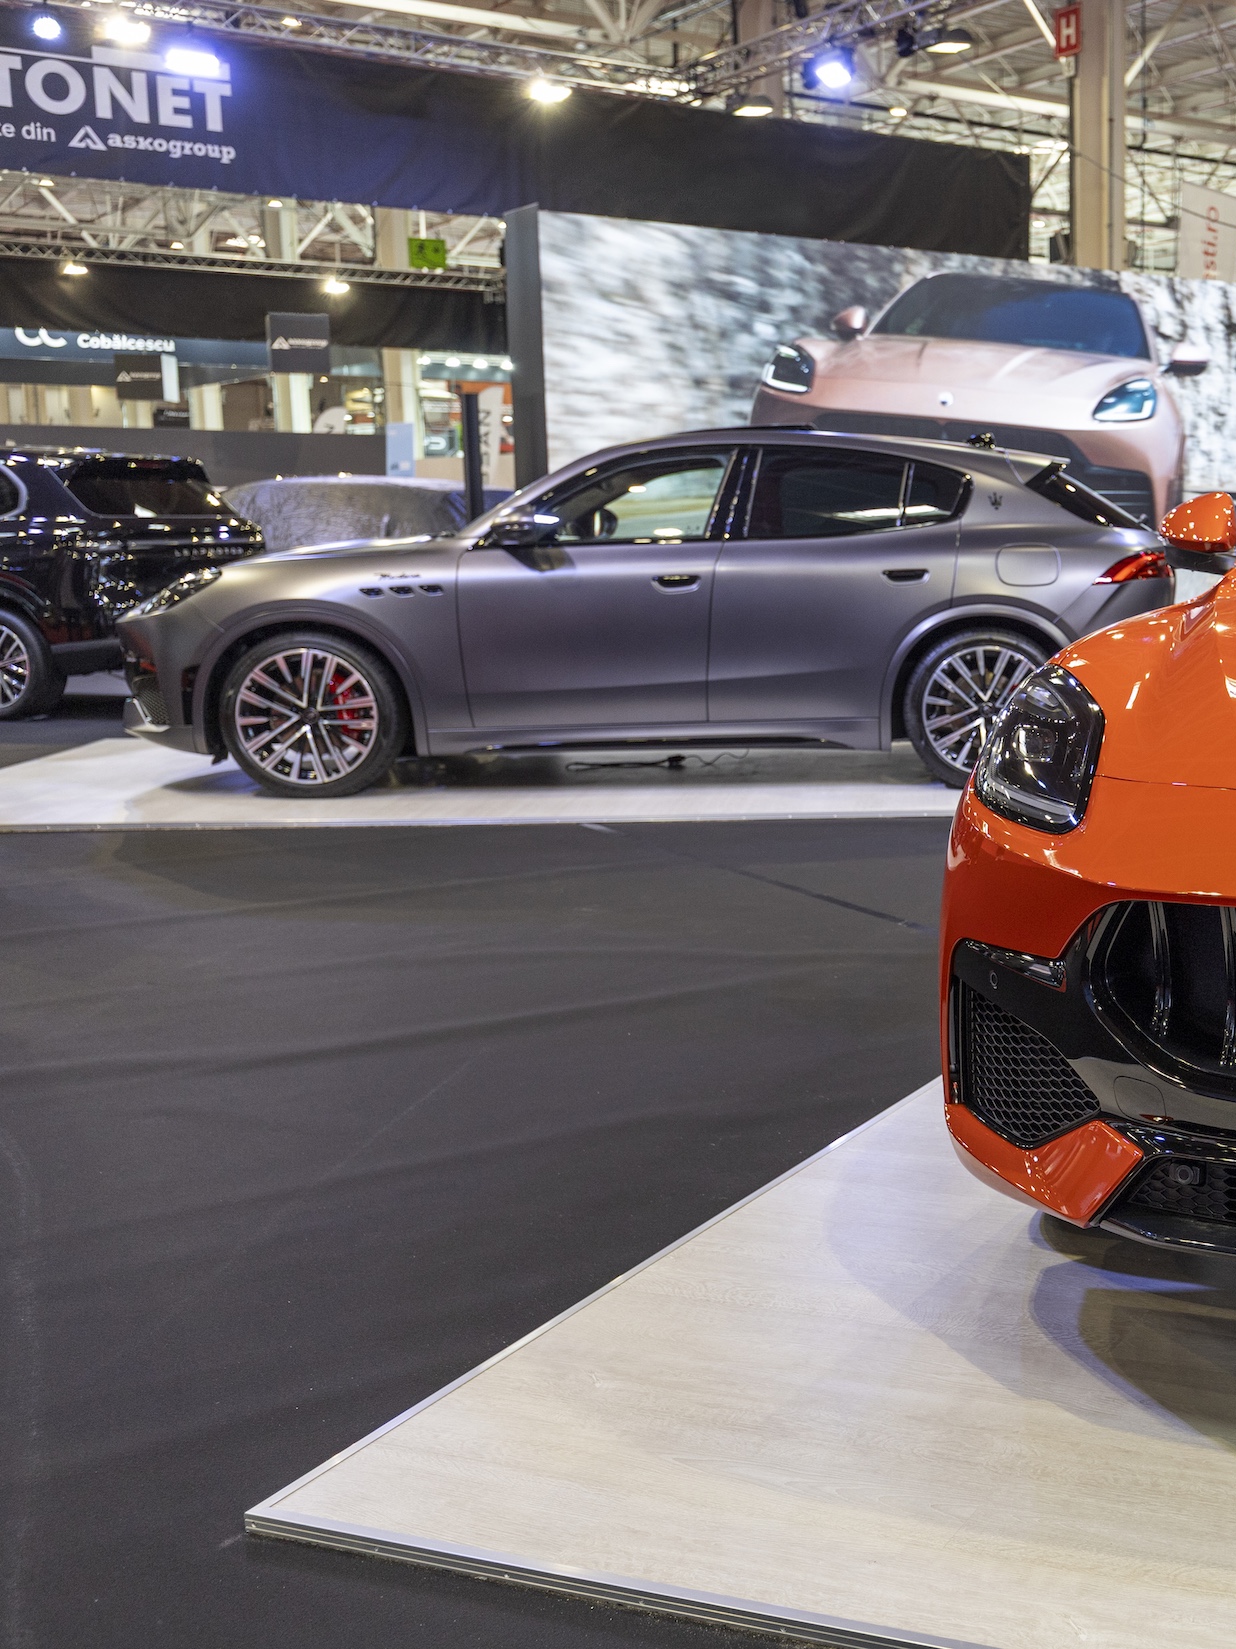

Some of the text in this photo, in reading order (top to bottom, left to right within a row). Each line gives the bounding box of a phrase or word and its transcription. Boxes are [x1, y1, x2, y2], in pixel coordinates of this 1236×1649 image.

[1060, 14, 1077, 49] H
[21, 121, 56, 142] din
[106, 132, 236, 164] askogroup
